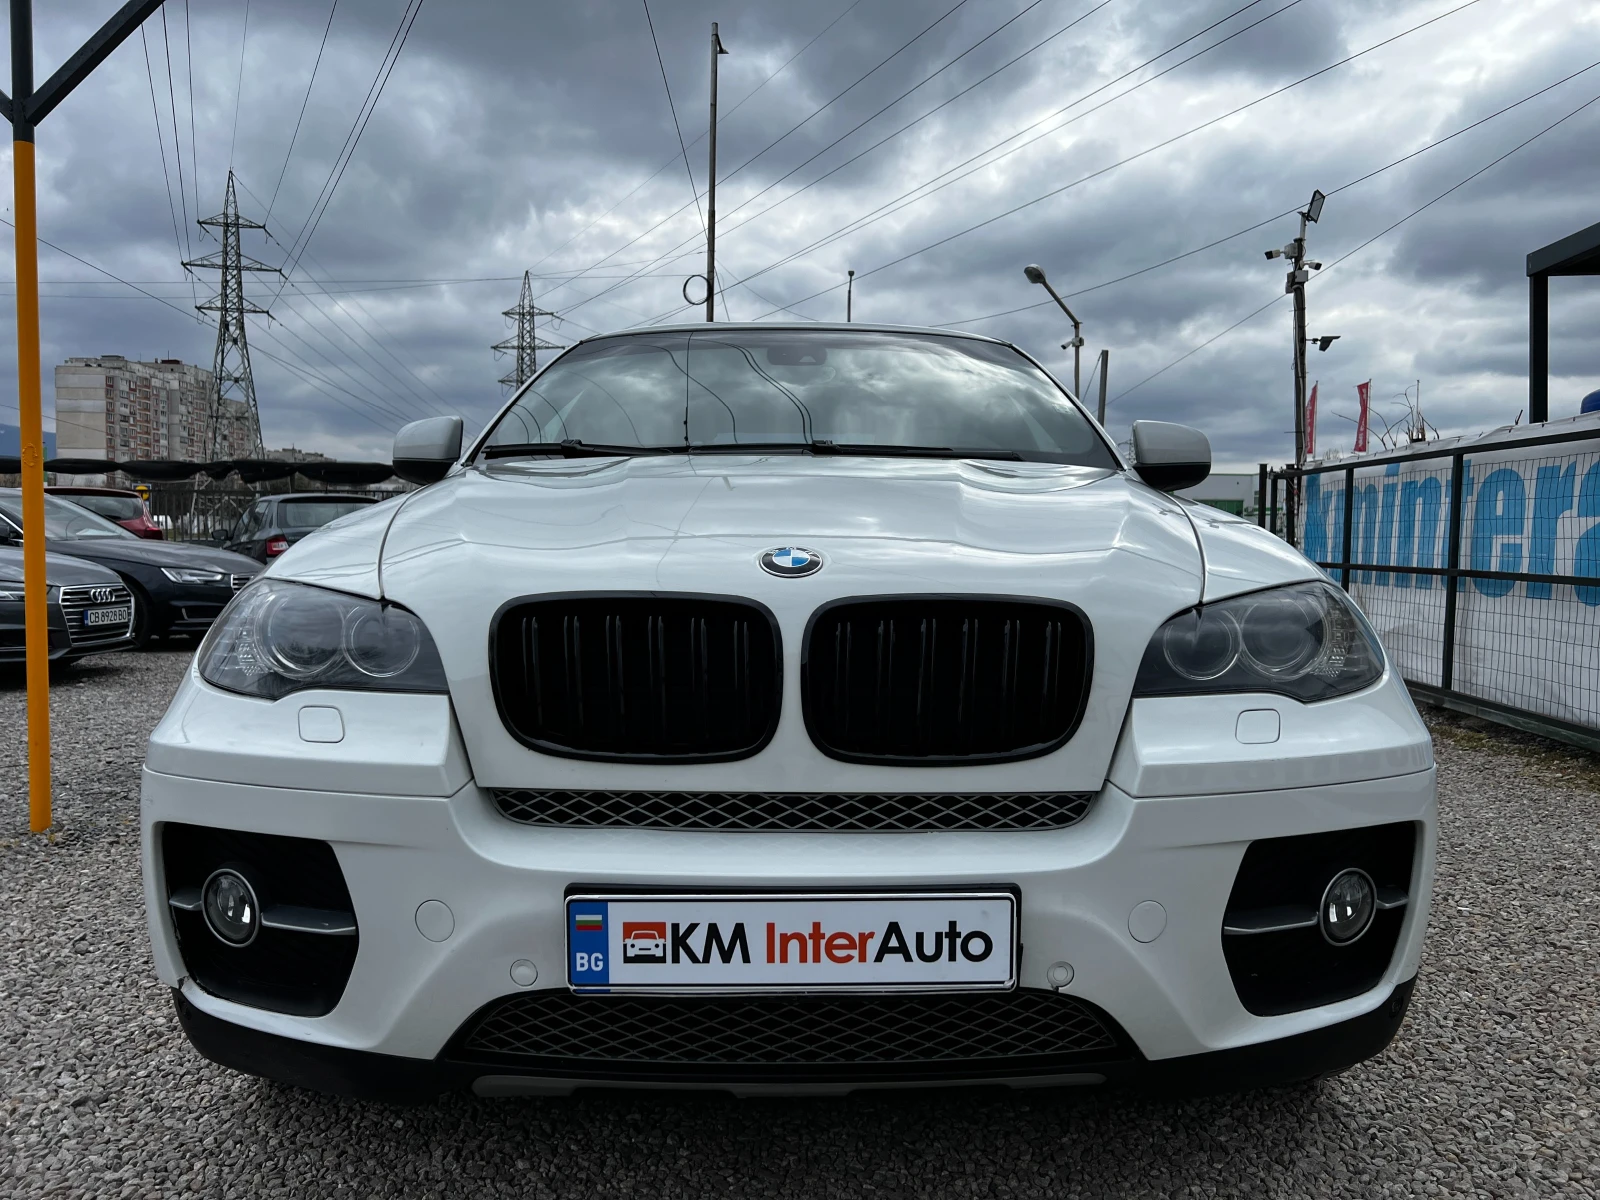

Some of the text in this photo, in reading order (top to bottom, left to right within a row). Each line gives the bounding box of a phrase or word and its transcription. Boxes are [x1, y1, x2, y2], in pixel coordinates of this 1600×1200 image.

[90, 611, 99, 623] CB
[671, 920, 994, 964] KM InterAuto
[576, 952, 603, 972] BG
